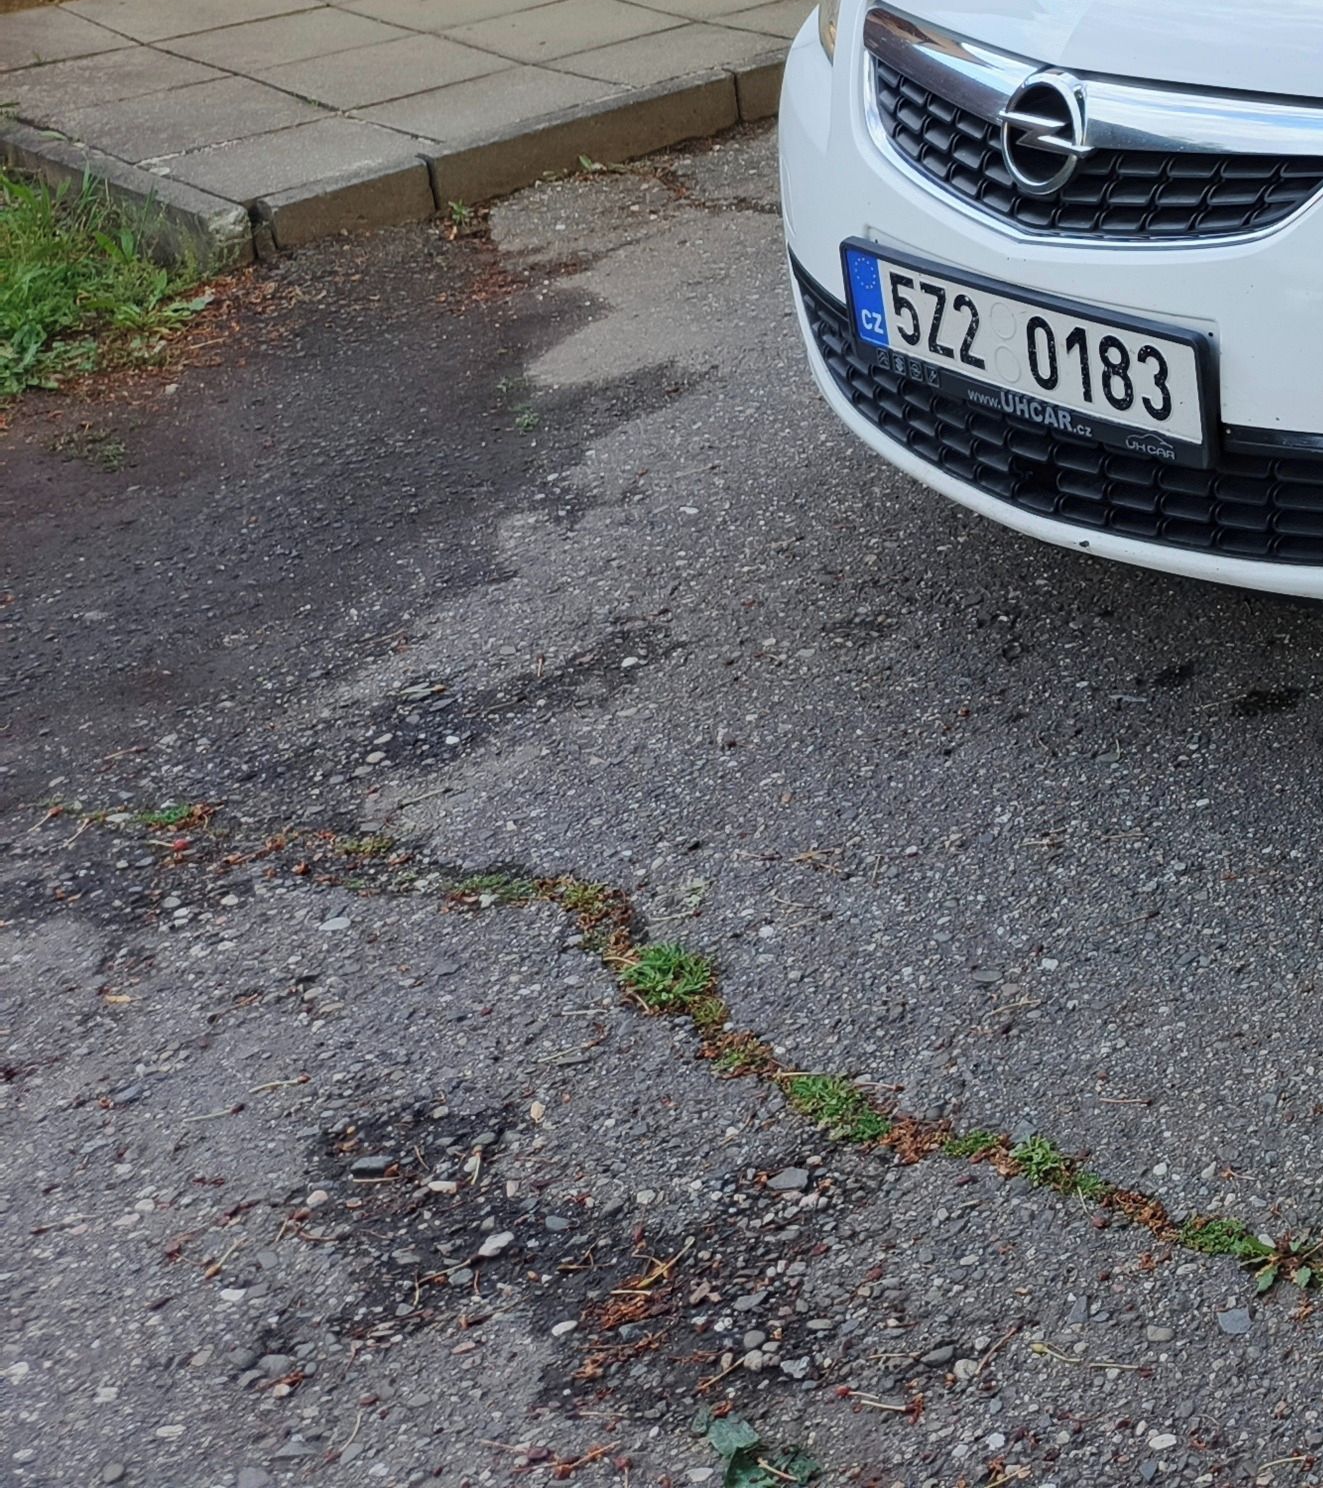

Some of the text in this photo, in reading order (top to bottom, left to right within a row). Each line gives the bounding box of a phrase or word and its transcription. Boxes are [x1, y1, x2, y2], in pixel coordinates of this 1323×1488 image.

[861, 308, 884, 334] CZ
[889, 271, 1172, 421] 5Z2 0183
[967, 389, 1093, 438] www.UHCAR.cz
